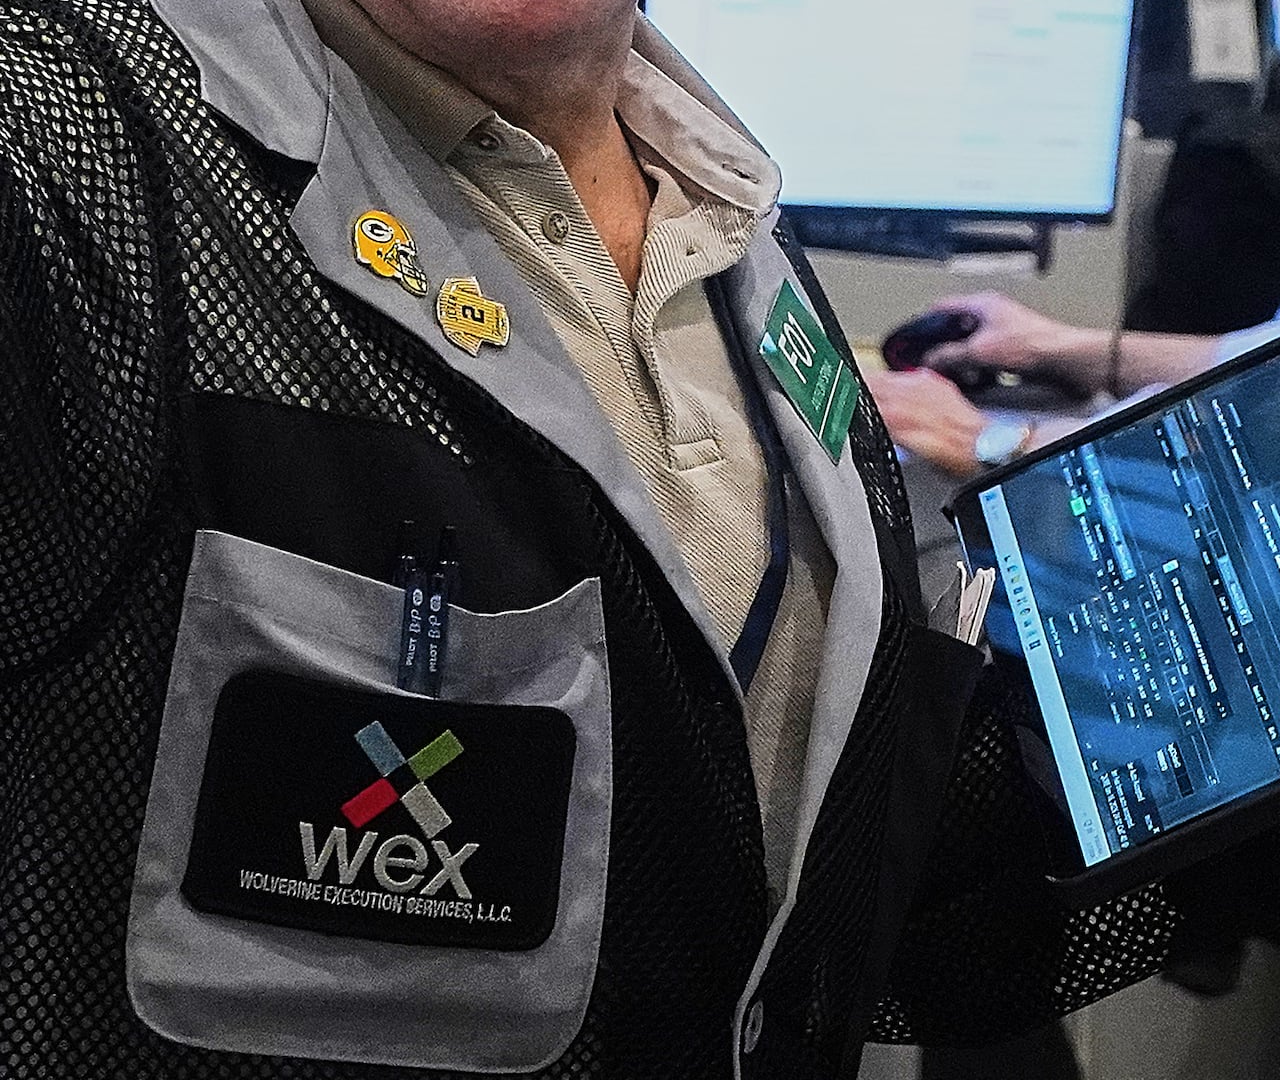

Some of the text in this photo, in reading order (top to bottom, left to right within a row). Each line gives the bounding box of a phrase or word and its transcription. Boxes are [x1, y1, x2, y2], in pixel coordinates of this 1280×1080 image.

[462, 305, 485, 324] 2
[299, 821, 480, 900] wex
[239, 869, 322, 901] WOLVERINE
[324, 885, 404, 914] EXECUTION
[406, 897, 474, 923] SERVICES,
